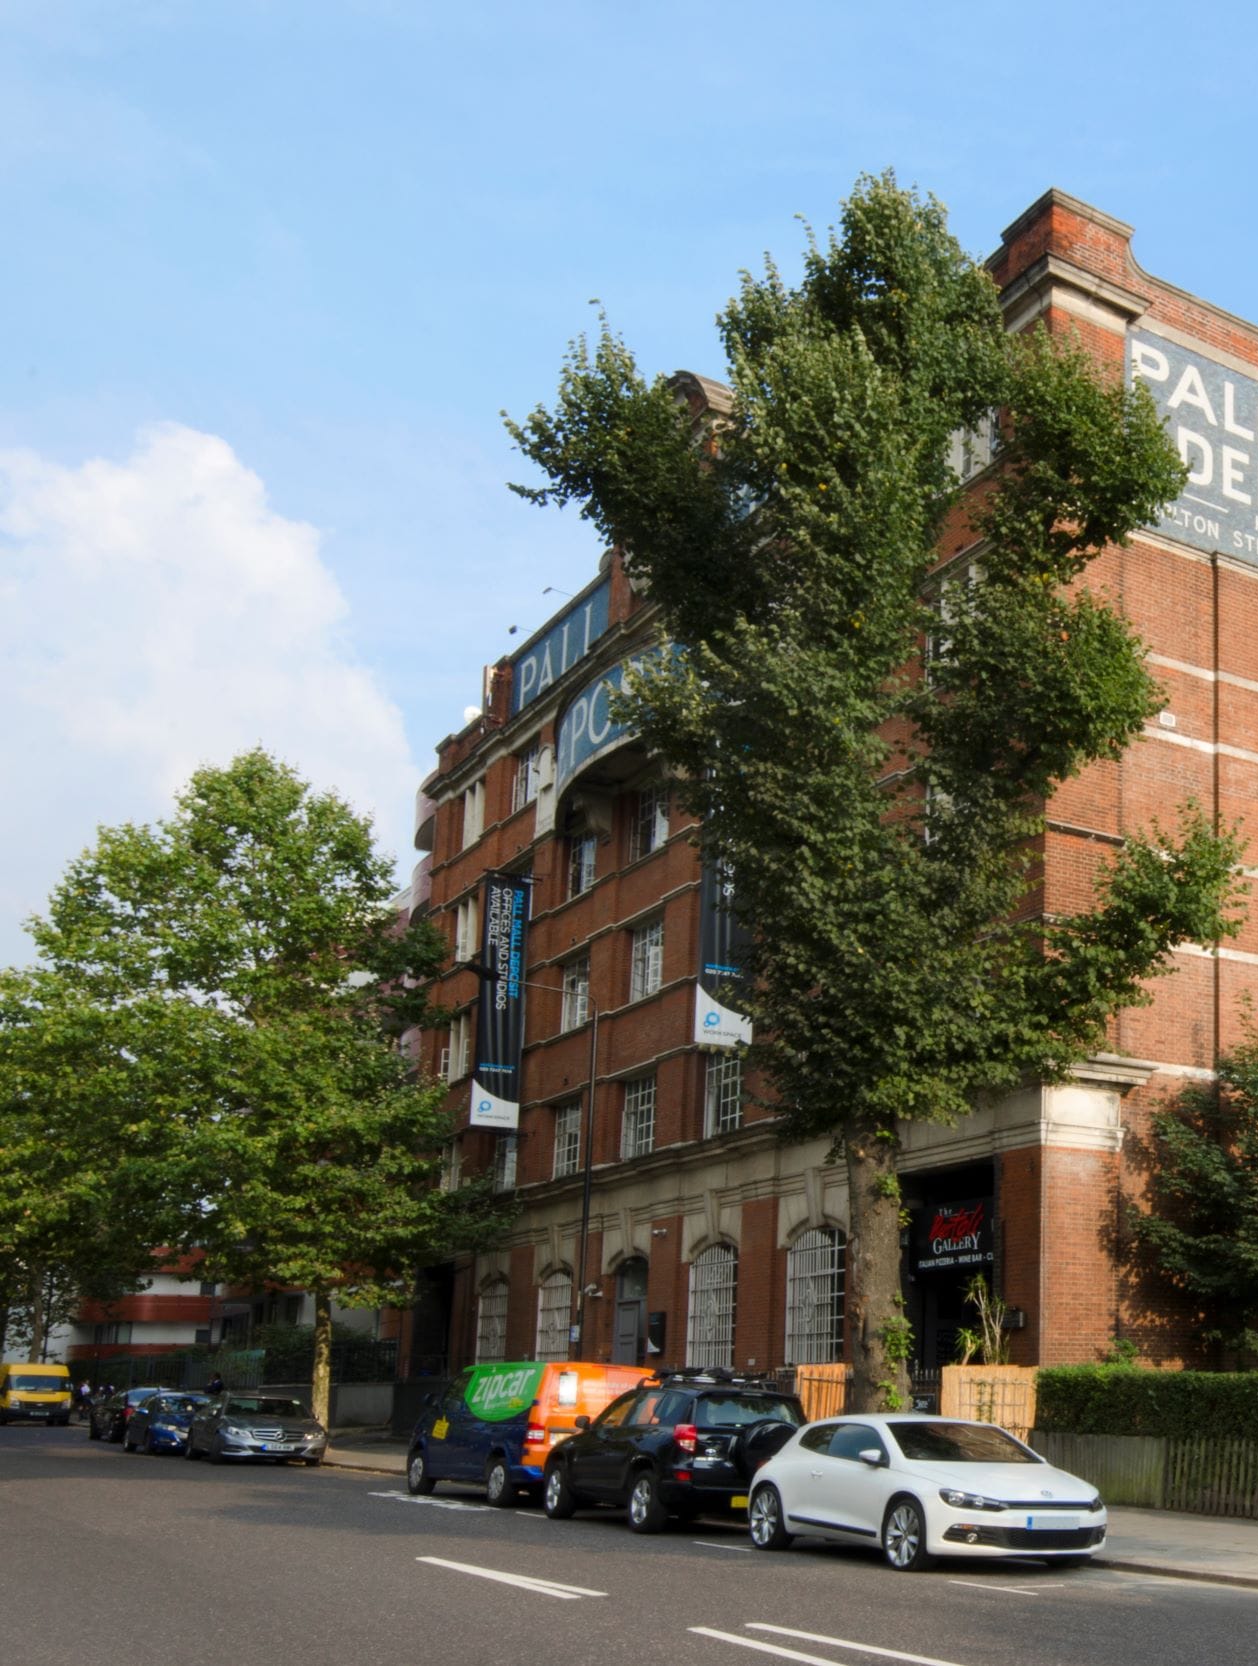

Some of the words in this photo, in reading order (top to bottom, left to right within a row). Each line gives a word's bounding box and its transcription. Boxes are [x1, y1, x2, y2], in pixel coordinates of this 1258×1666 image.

[488, 885, 502, 946] AVAILABLE
[500, 888, 513, 933] OFFICES
[512, 889, 524, 916] PALL
[499, 935, 510, 960] AND
[511, 918, 523, 948] MALL
[508, 951, 521, 999] DEPOSIT
[472, 1368, 536, 1411] zipcar
